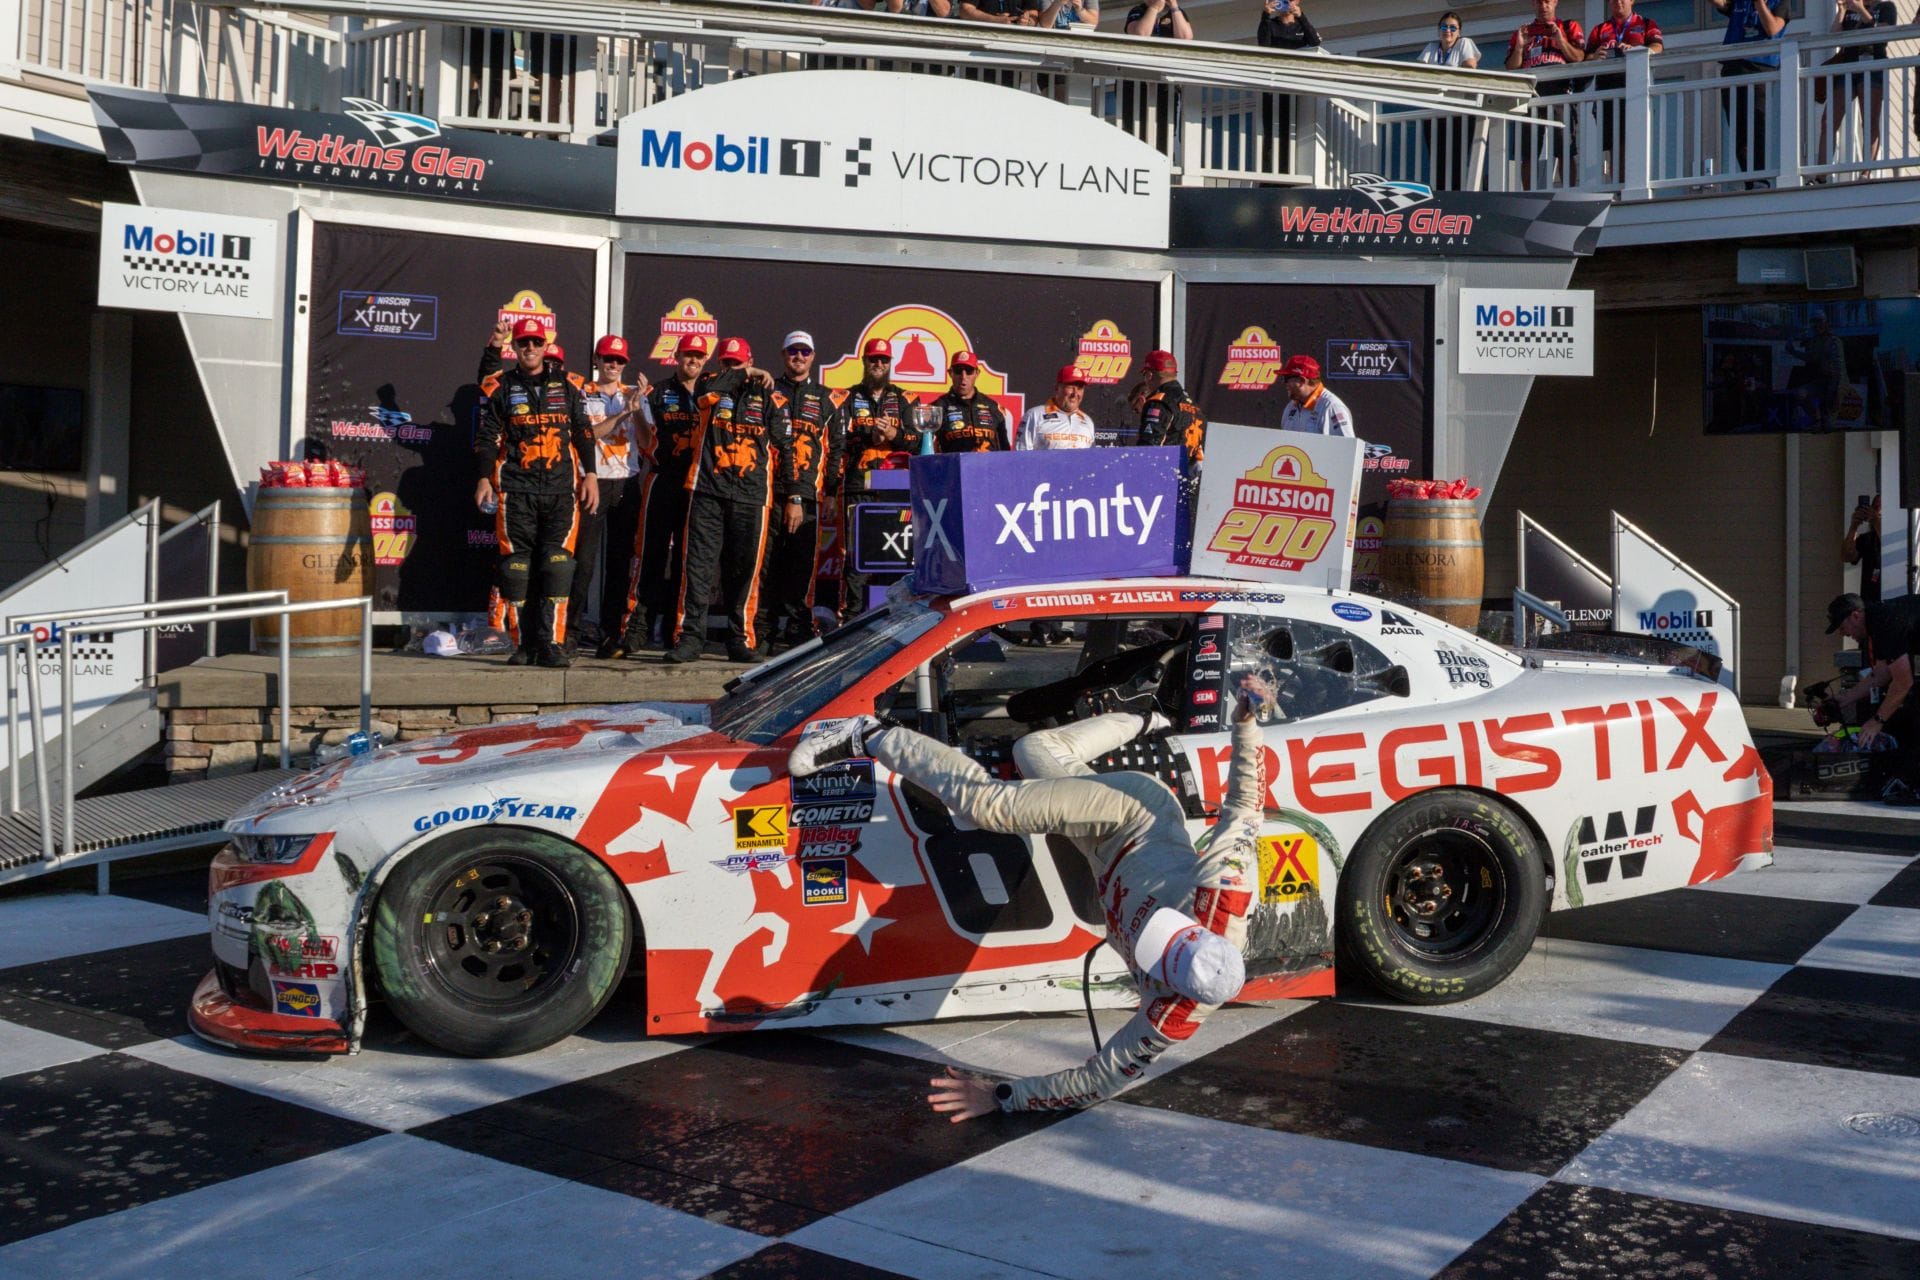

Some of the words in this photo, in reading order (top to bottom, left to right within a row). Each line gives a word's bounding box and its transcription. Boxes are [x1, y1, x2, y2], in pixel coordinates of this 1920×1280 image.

[256, 126, 405, 171] Watkins
[411, 146, 486, 181] Glen
[642, 129, 769, 174] Mobil
[259, 159, 481, 191] INTERNATIONAL
[892, 151, 1047, 188] VICTORY
[1059, 164, 1150, 196] LANE
[1281, 205, 1402, 235] Watkins
[1408, 208, 1473, 235] Glen
[123, 224, 214, 258] Mobil
[1284, 234, 1470, 246] INTERNATIONAL
[123, 275, 199, 295] VICTORY
[203, 278, 249, 298] LANE
[376, 297, 411, 306] NASCAR
[354, 306, 422, 330] xfinity
[1476, 304, 1546, 328] Mobil
[373, 325, 401, 334] SERIES
[1359, 343, 1388, 351] NASCAR
[1476, 345, 1534, 360] VICTORY
[1537, 346, 1574, 360] LANE
[1340, 351, 1398, 372] xfinity
[1218, 362, 1282, 385] 200
[1356, 368, 1381, 376] SERIES
[331, 420, 396, 438] Watkins
[399, 424, 433, 440] Glen
[1094, 432, 1118, 440] ASCAR
[1380, 456, 1409, 469] Glen
[371, 517, 414, 530] ISSION
[995, 482, 1164, 554] xfinity
[1211, 510, 1335, 562] 200
[373, 533, 417, 558] 00
[1235, 554, 1249, 563] AT
[1250, 556, 1268, 565] THE
[1269, 557, 1294, 568] GLEN
[1025, 593, 1095, 608] CONNOR
[1110, 591, 1174, 605] ZILISCH
[1563, 608, 1612, 621] GLENOR
[1640, 610, 1692, 630] Mobil
[1380, 626, 1425, 636] AXALTA
[1435, 649, 1490, 668] Blues
[75, 664, 114, 676] LANE
[1448, 667, 1490, 688] Hog
[1196, 693, 1213, 702] SEM
[1197, 691, 1728, 826] REGISTIX
[805, 773, 862, 793] xfinity
[822, 788, 846, 796] SERIES
[414, 797, 578, 832] GOODYEAR
[792, 803, 872, 824] COMETIC
[736, 838, 786, 849] KENNAMETAL
[801, 826, 861, 845] Holley
[728, 854, 751, 865] FIVE
[755, 852, 781, 863] STAR
[800, 843, 849, 858] MSD
[807, 870, 842, 881] SUNOCO
[806, 887, 844, 897] ROOKIE
[1265, 881, 1313, 898] KOA
[278, 992, 319, 1004] SUNOCO
